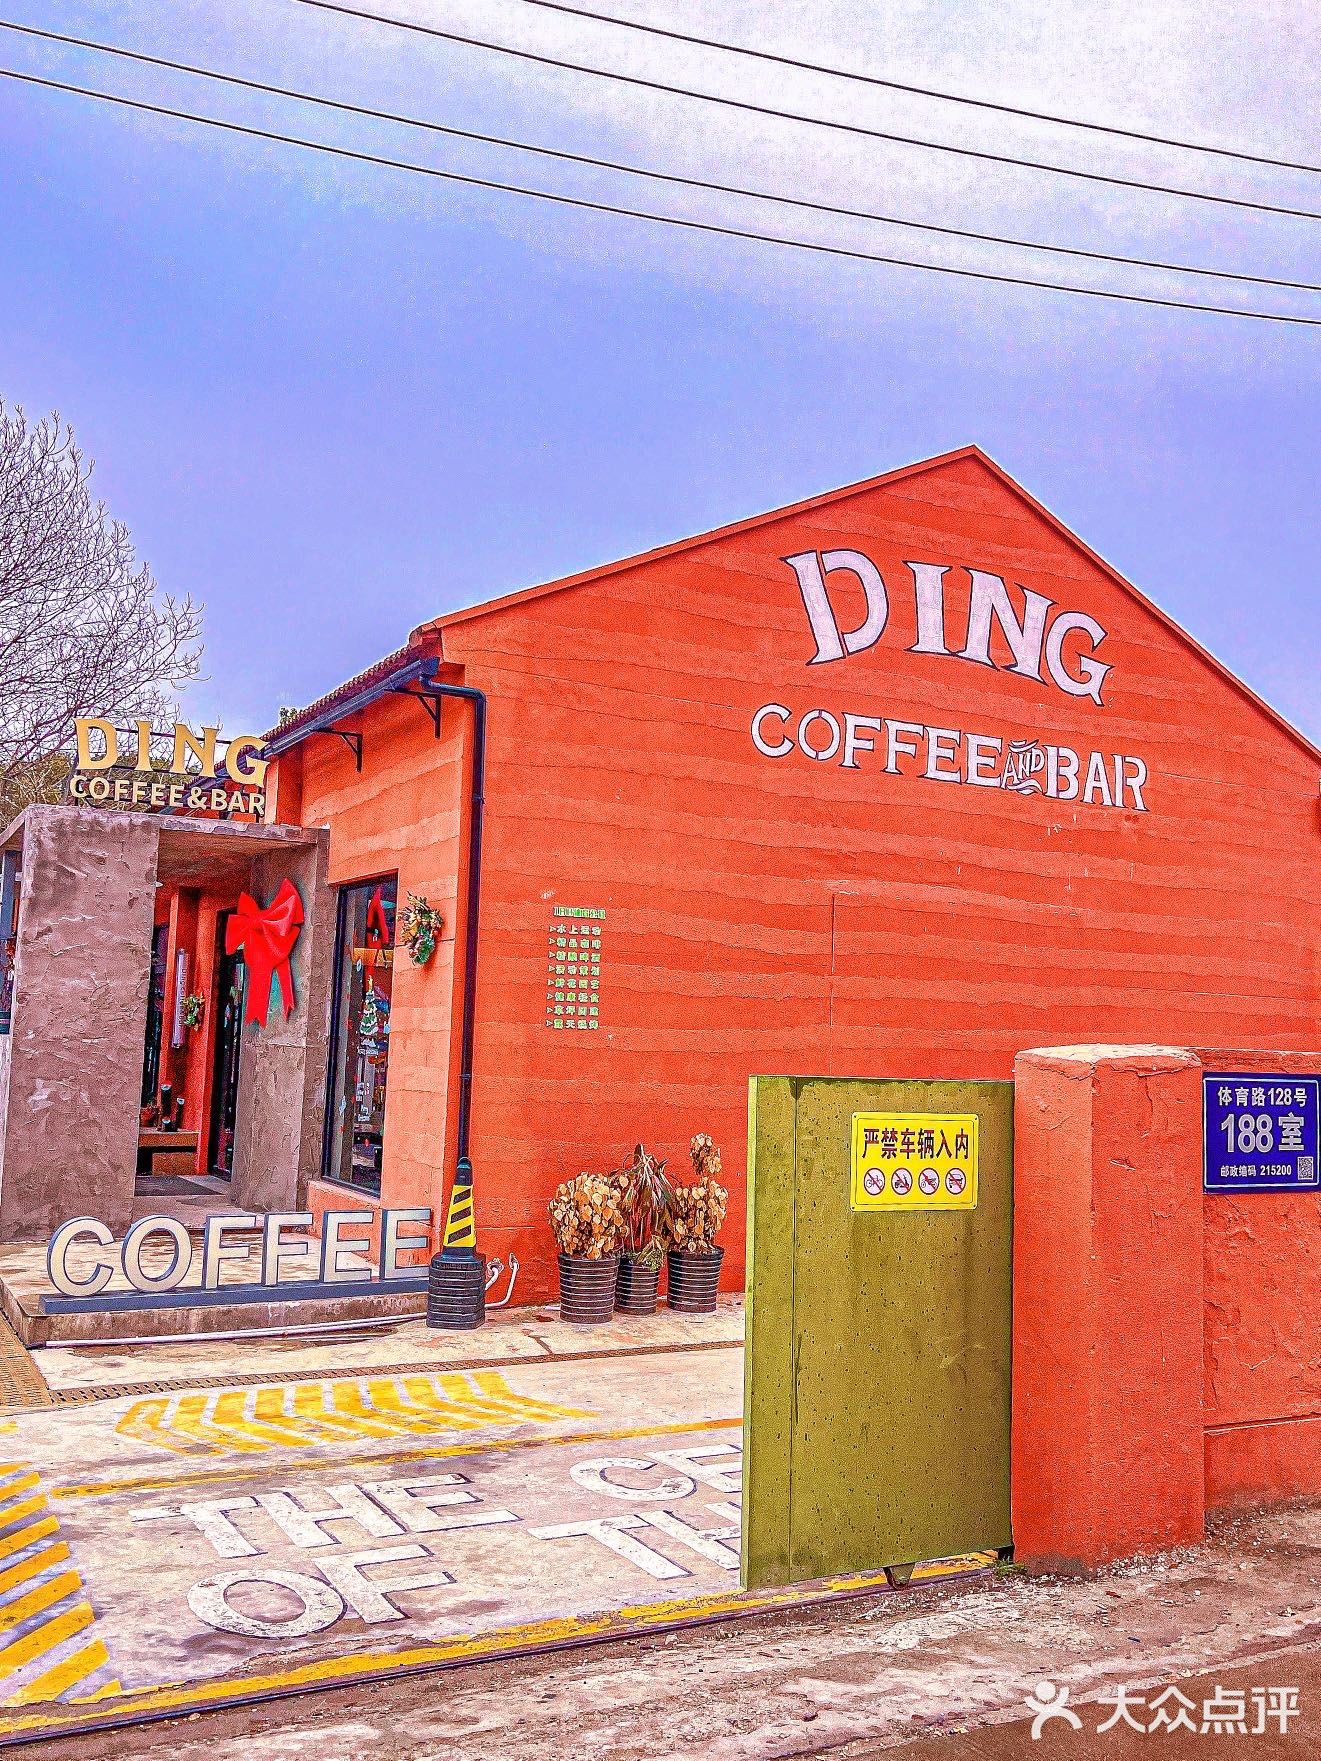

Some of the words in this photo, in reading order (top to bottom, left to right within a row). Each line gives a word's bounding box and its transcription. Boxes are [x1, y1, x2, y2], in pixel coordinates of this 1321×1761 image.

[779, 549, 1114, 706] DING
[73, 718, 270, 788] DING
[751, 703, 1002, 787] COFFEE
[1001, 742, 1046, 792] AND
[1041, 745, 1150, 811] BAR
[69, 774, 265, 817] COFFEE&BAR
[1217, 1086, 1307, 1107] 体育路128号
[862, 1127, 969, 1160] 严禁车辆入内
[1220, 1111, 1305, 1153] 188室
[1220, 1165, 1257, 1177] 邮政编码
[1260, 1164, 1292, 1176] 215200
[48, 1208, 432, 1297] COFFEE
[130, 1473, 521, 1558] THE
[188, 1545, 456, 1639] OF
